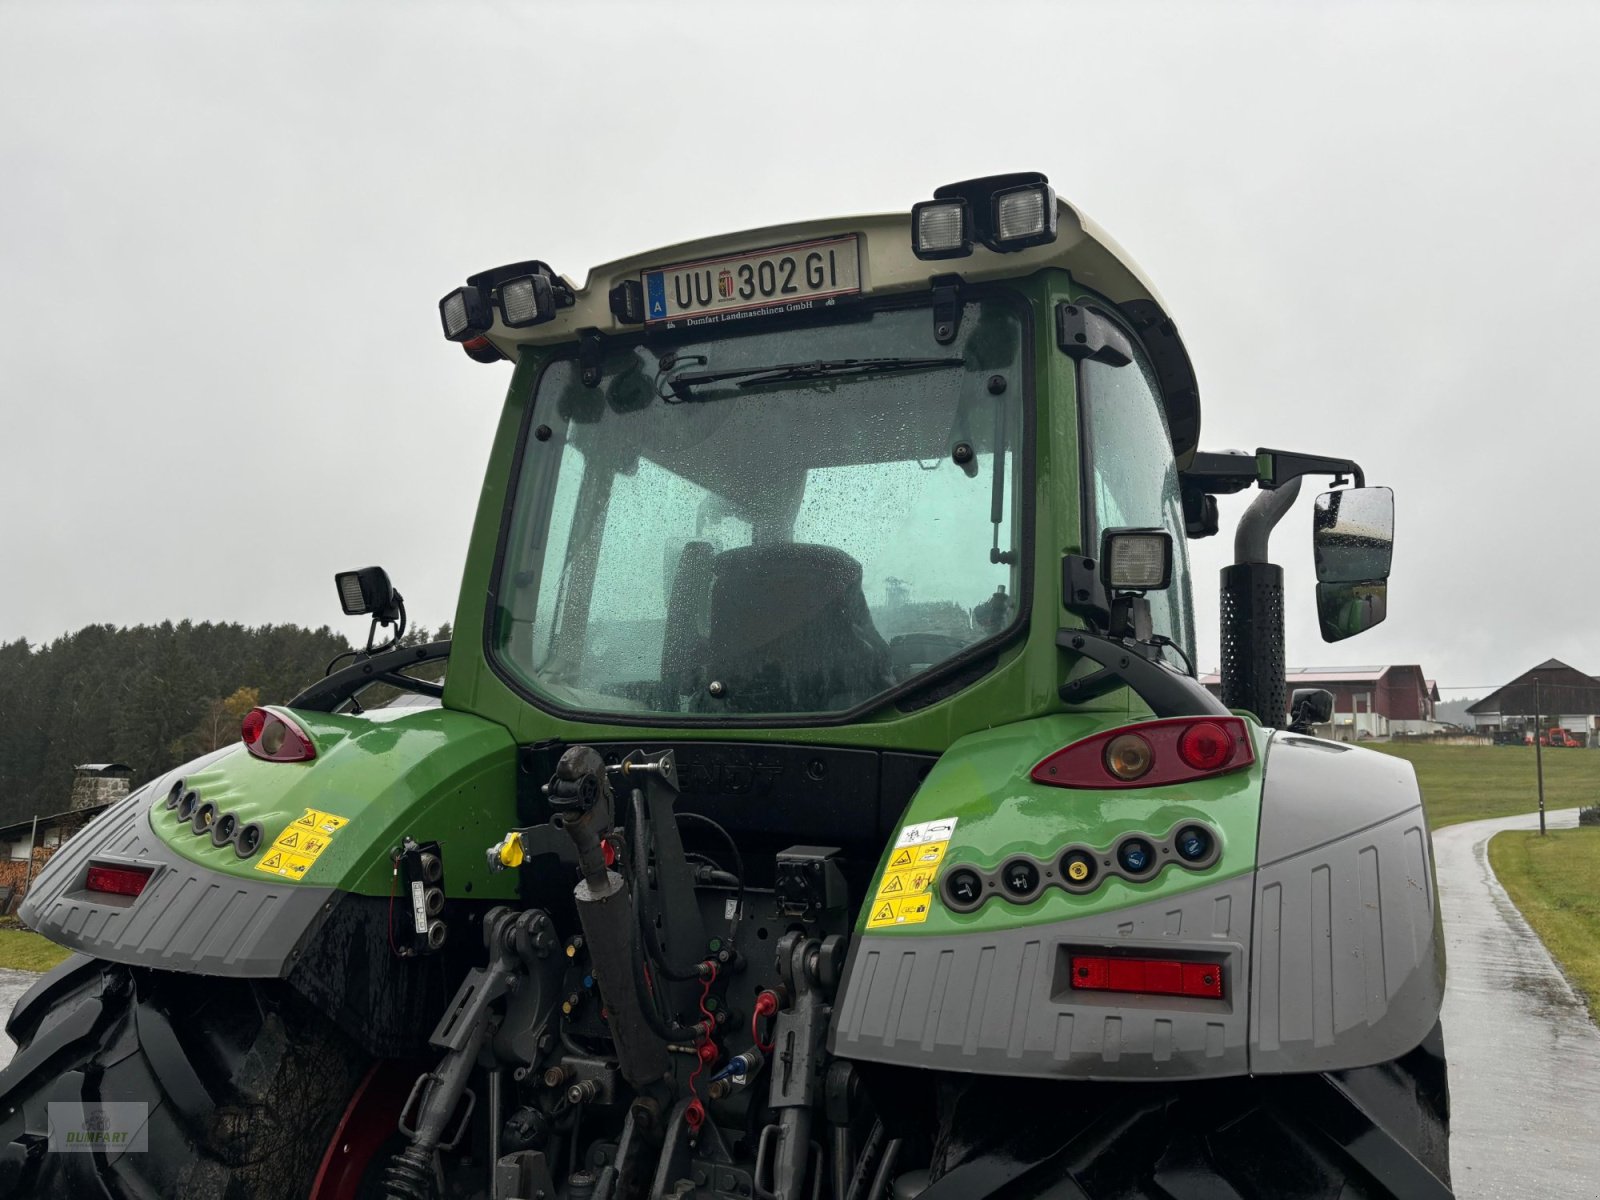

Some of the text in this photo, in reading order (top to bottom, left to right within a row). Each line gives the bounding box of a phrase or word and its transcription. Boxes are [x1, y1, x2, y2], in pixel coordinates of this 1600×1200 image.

[675, 250, 836, 310] UU 302 GI
[654, 302, 663, 313] A
[687, 301, 813, 327] Dumfart Landmaschinen GmbH
